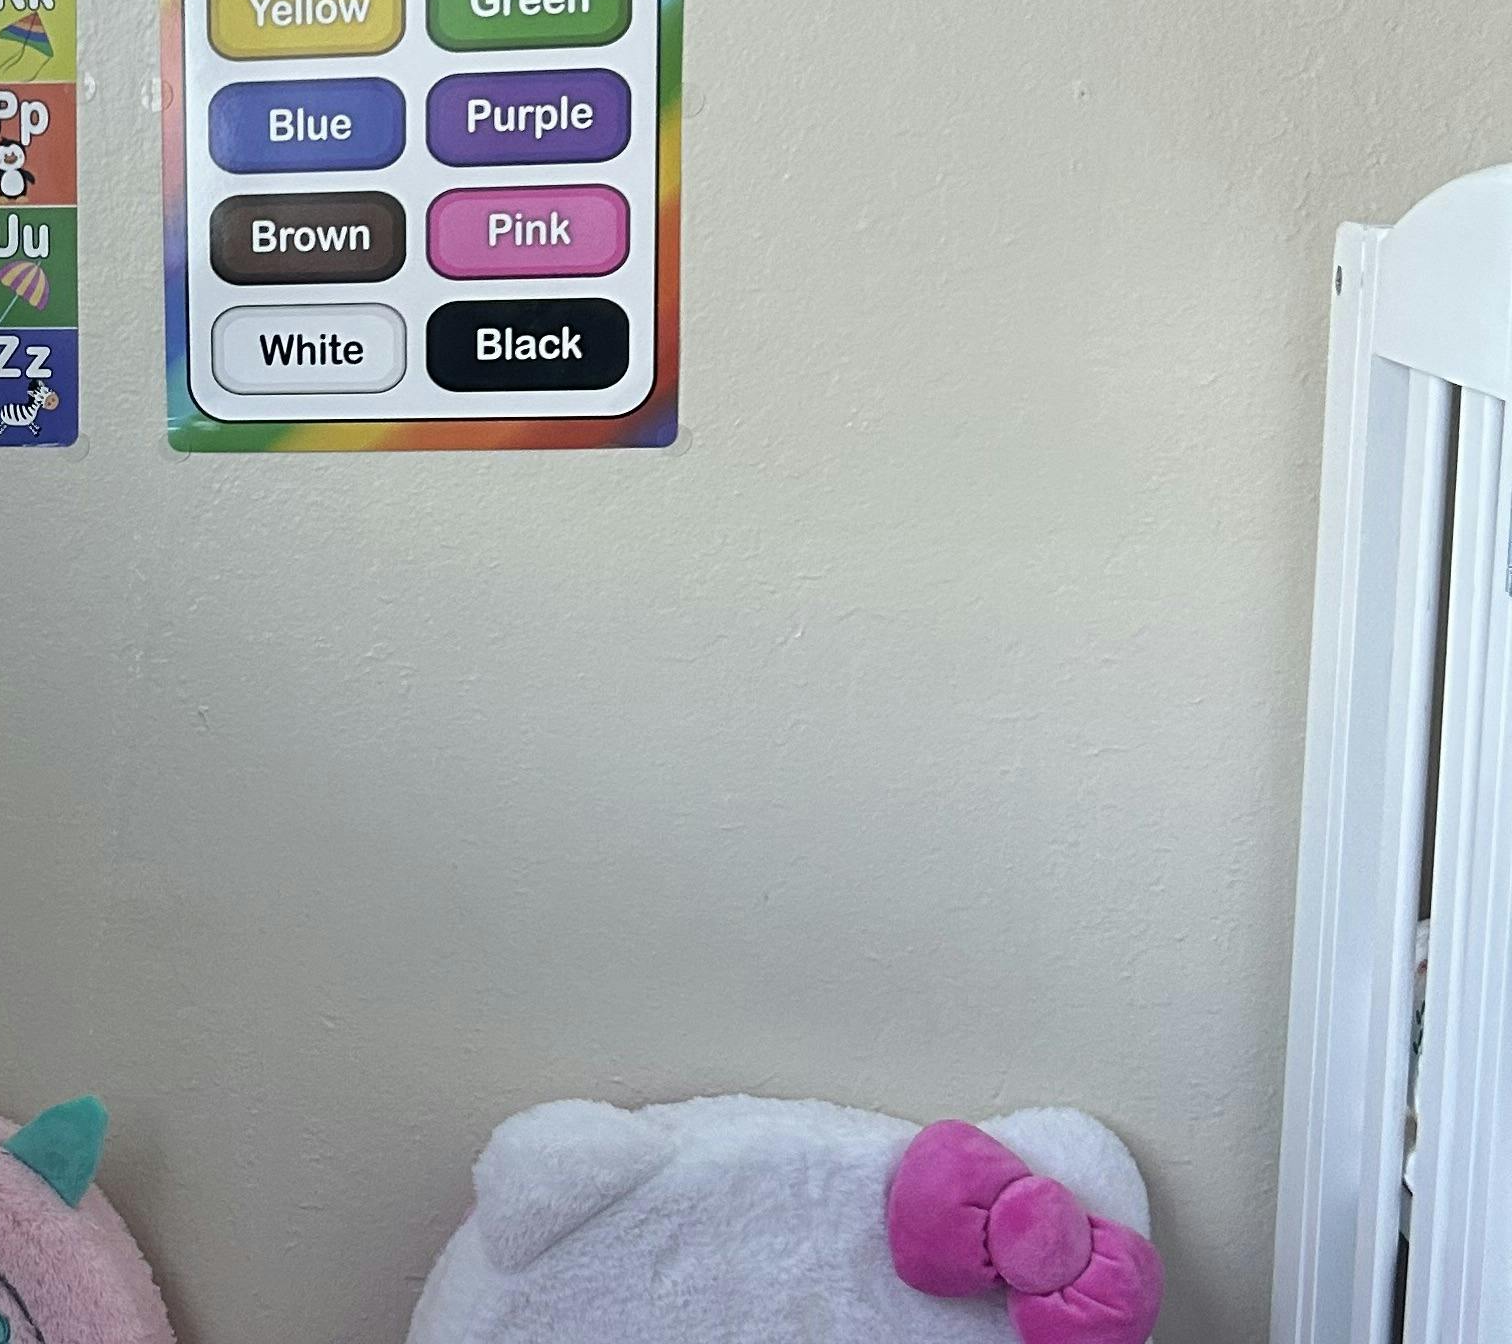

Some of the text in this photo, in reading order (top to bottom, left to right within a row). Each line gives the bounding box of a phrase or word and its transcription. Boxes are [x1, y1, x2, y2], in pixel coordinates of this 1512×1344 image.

[268, 95, 594, 144] Blue Purple
[251, 212, 571, 254] Brown Pink
[259, 326, 583, 366] White Black
